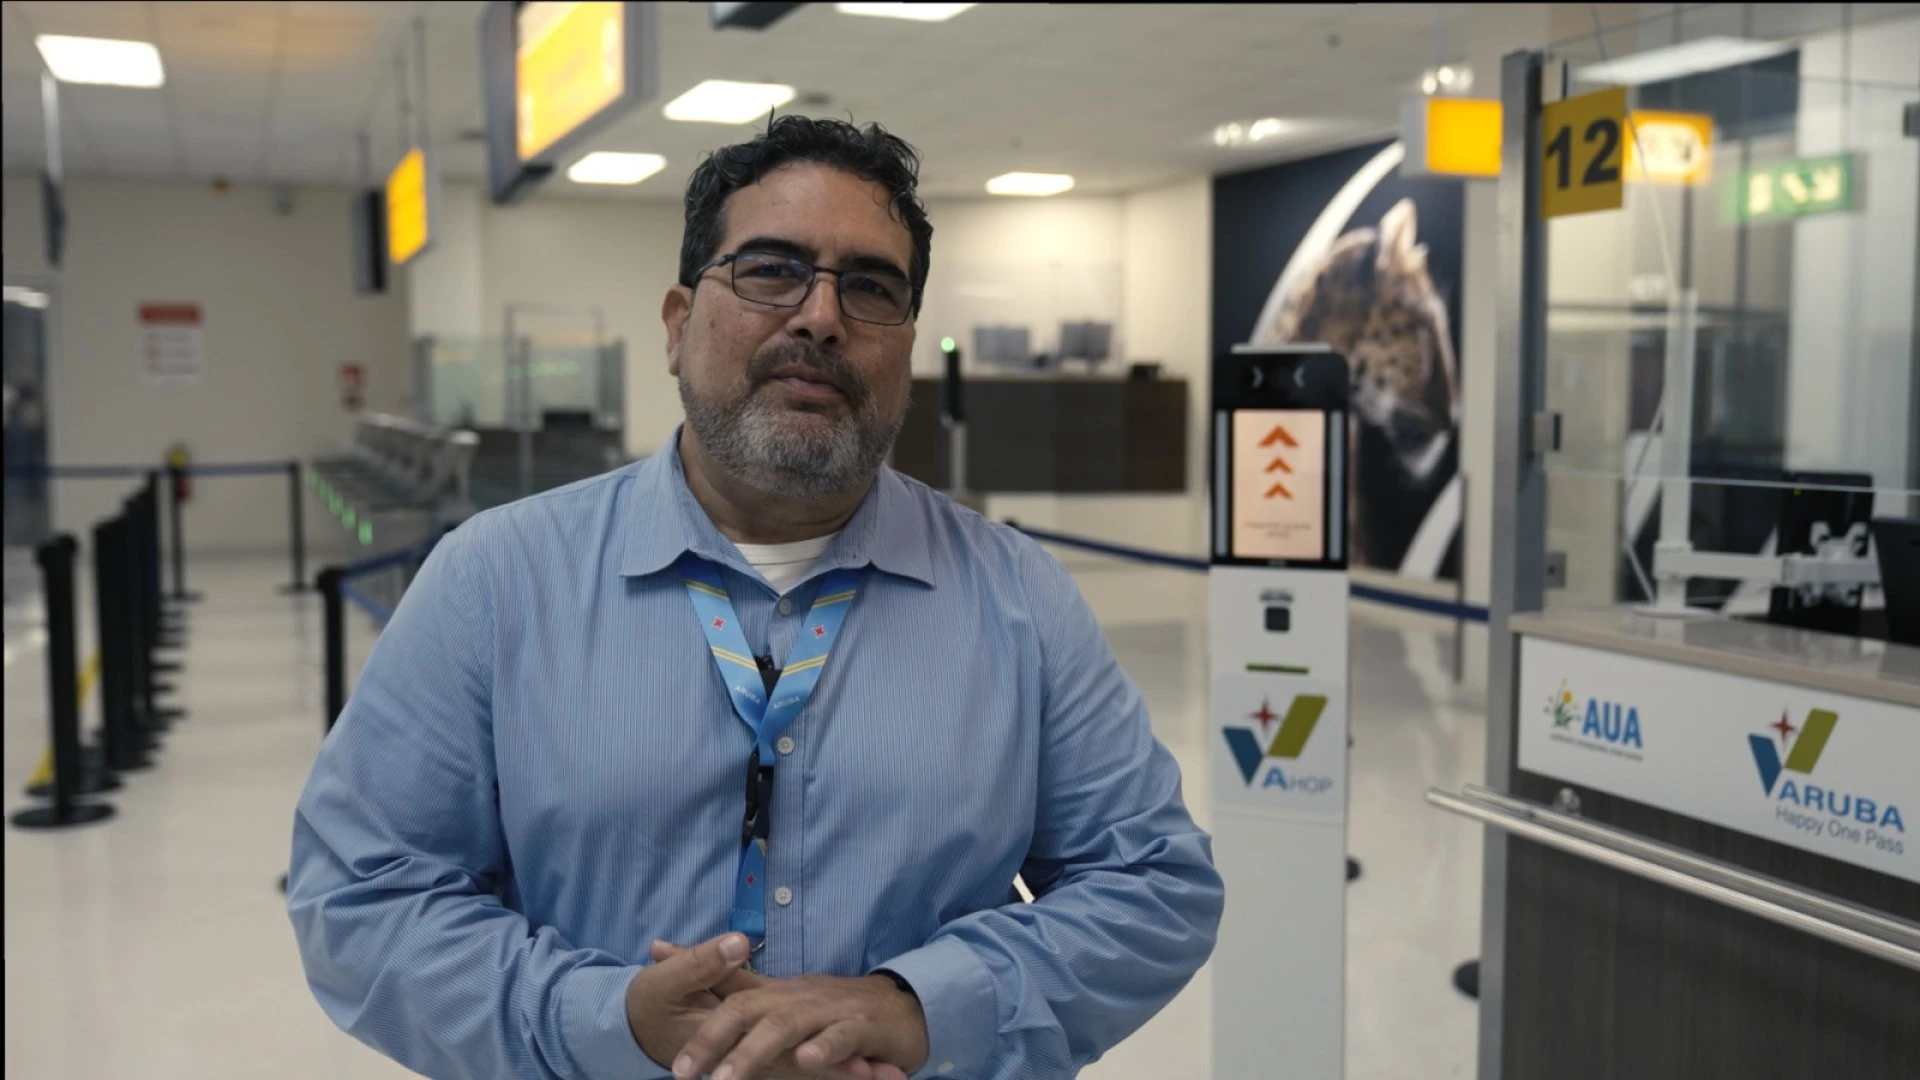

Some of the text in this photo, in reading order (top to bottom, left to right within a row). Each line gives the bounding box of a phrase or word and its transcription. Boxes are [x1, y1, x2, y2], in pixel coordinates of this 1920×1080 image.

[1546, 118, 1619, 191] 12
[1582, 696, 1643, 749] AUA
[1775, 804, 1904, 855] Happy One Pass
[1779, 779, 1905, 833] ARUBA
